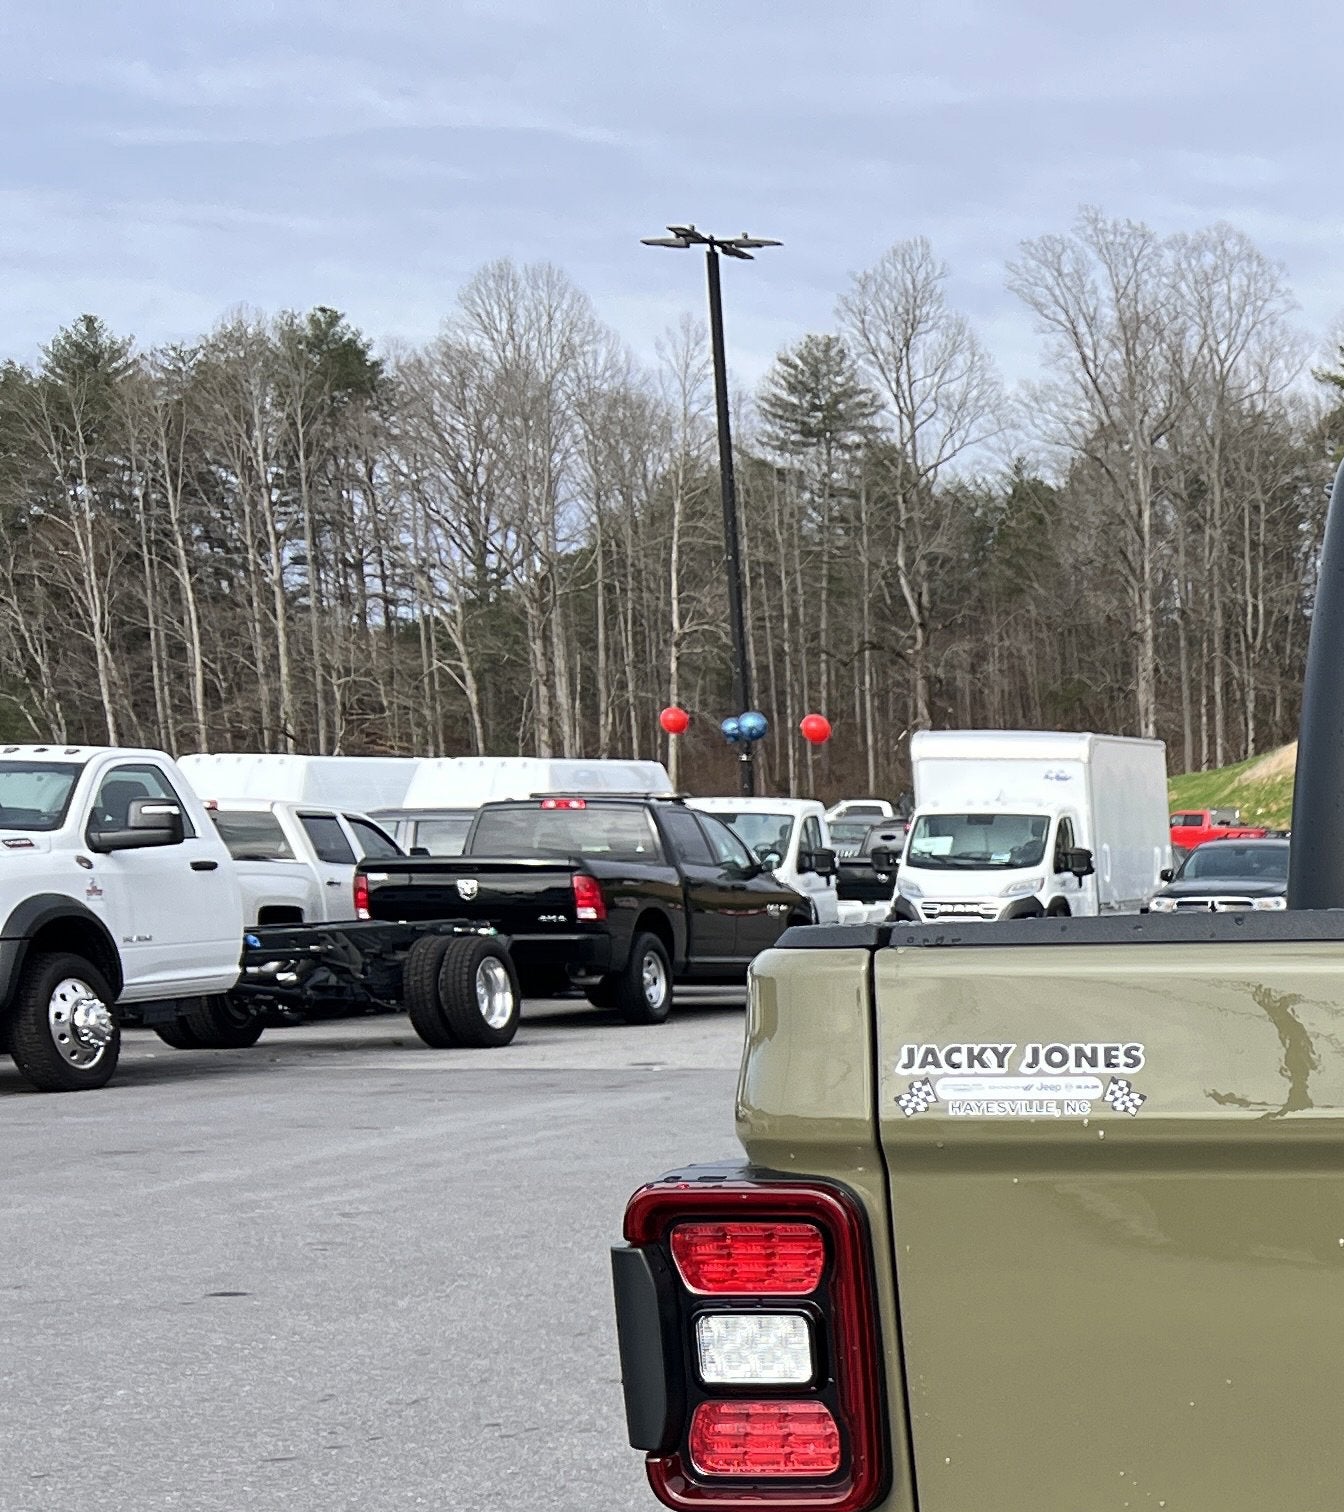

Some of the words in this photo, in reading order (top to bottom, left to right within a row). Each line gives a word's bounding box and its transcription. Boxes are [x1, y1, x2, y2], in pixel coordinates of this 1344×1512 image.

[900, 1044, 1014, 1071] JACKY
[1023, 1044, 1144, 1071] JONES
[949, 1101, 1061, 1117] HAYESVILLE,
[1065, 1100, 1092, 1114] NC
